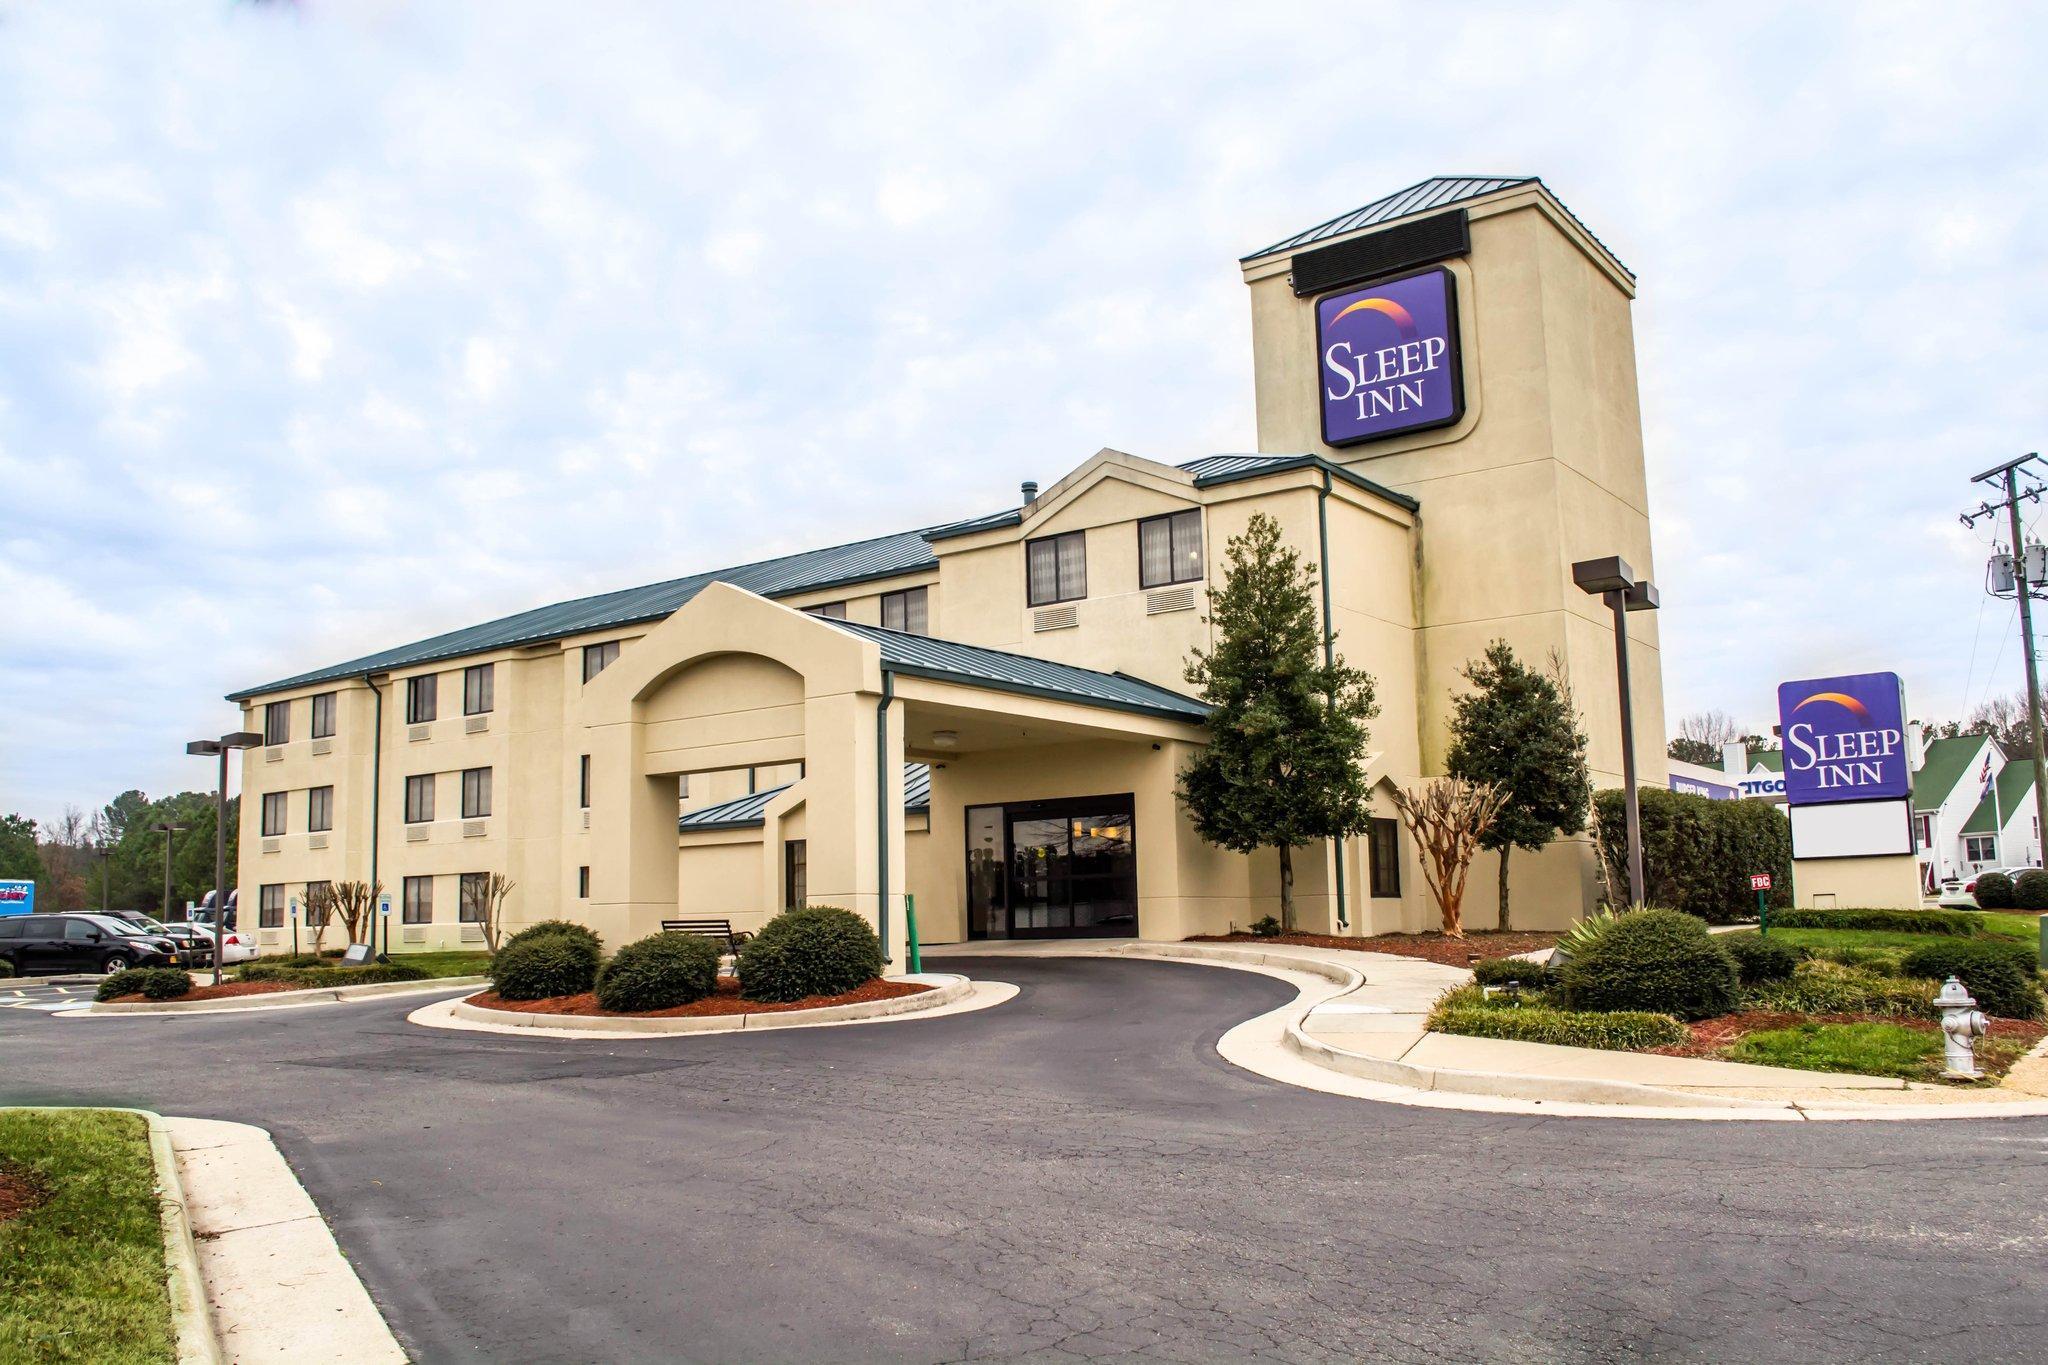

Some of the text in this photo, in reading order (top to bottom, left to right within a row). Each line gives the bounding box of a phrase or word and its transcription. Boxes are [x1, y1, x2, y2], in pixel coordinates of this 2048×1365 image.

[1325, 336, 1446, 401] SLEEP
[1355, 379, 1425, 420] INN
[1788, 723, 1900, 770] SLEEP
[1816, 761, 1883, 789] INN
